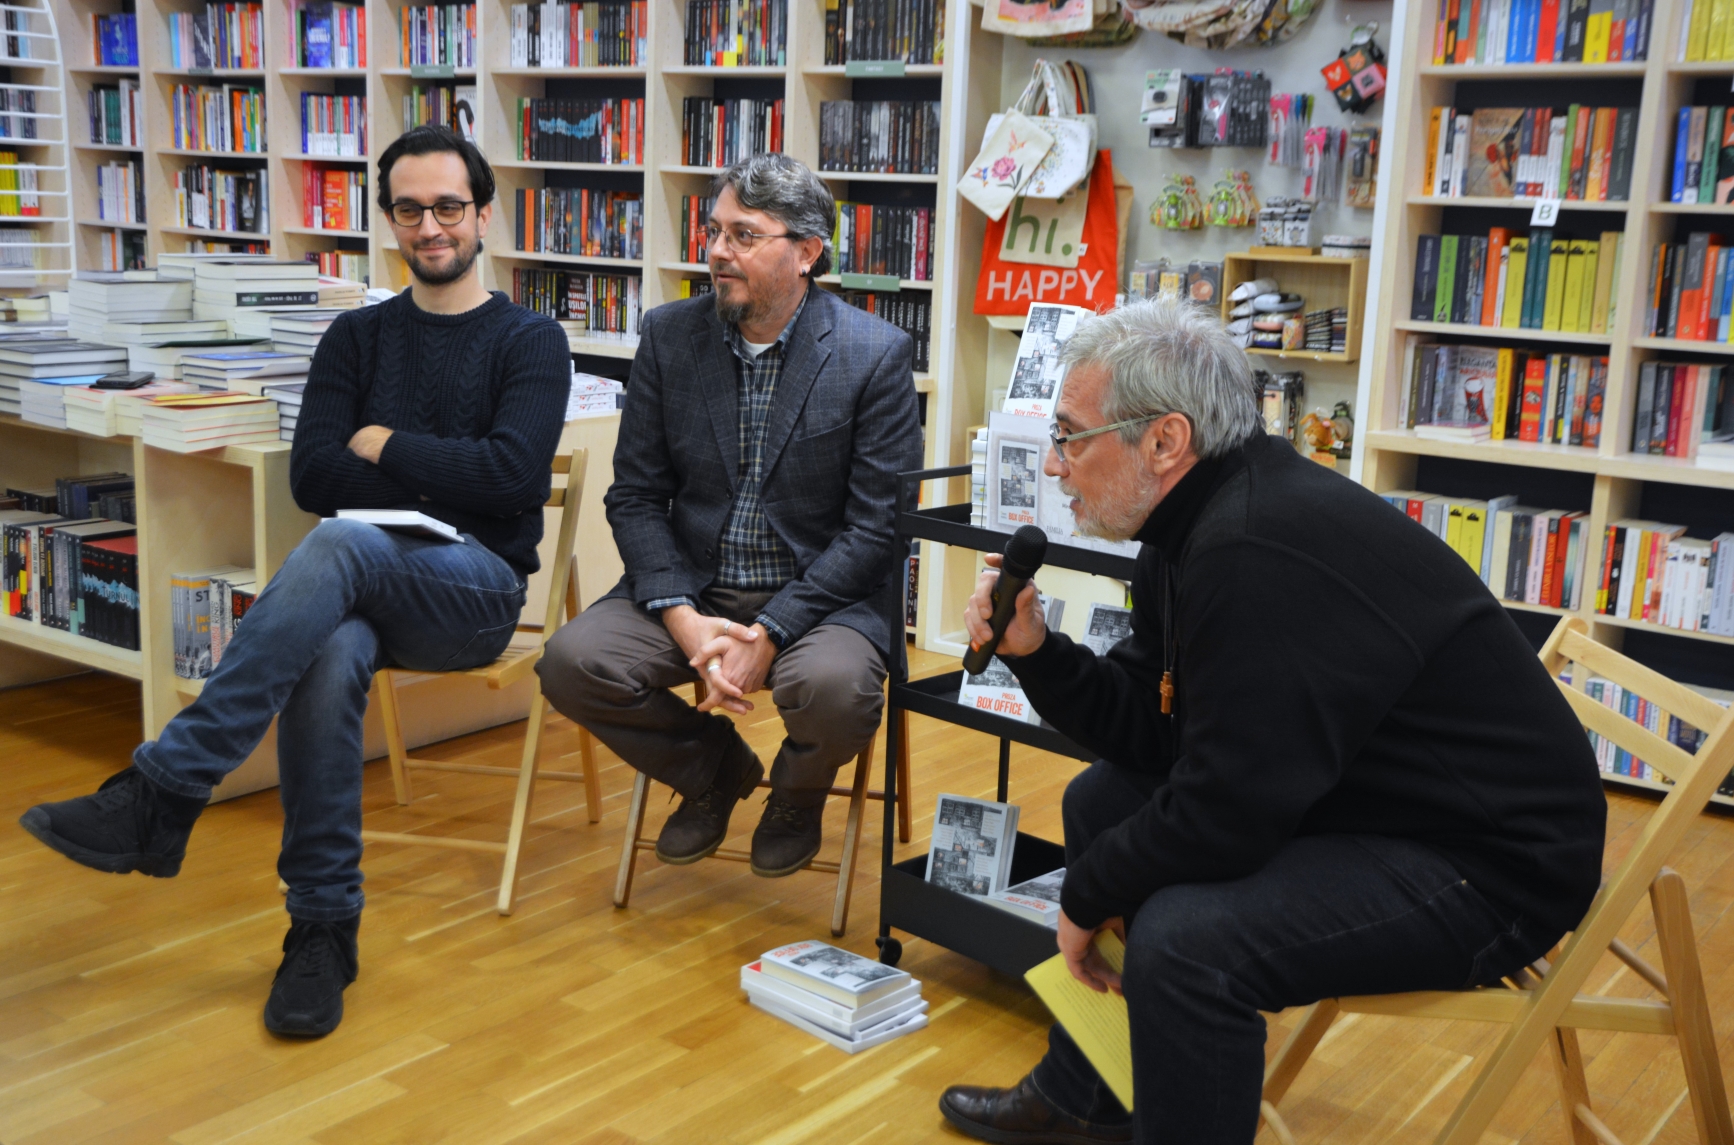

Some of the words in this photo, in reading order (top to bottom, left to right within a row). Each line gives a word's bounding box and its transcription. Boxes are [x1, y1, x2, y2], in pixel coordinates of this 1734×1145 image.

[1538, 204, 1552, 220] B
[986, 270, 1104, 300] HAPPY
[1008, 511, 1018, 521] BOX
[1018, 514, 1034, 524] OFFICE
[102, 585, 130, 602] TURNUL
[908, 560, 916, 614] PAOLINI
[976, 696, 993, 710] BOX
[994, 699, 1023, 716] OFFICE
